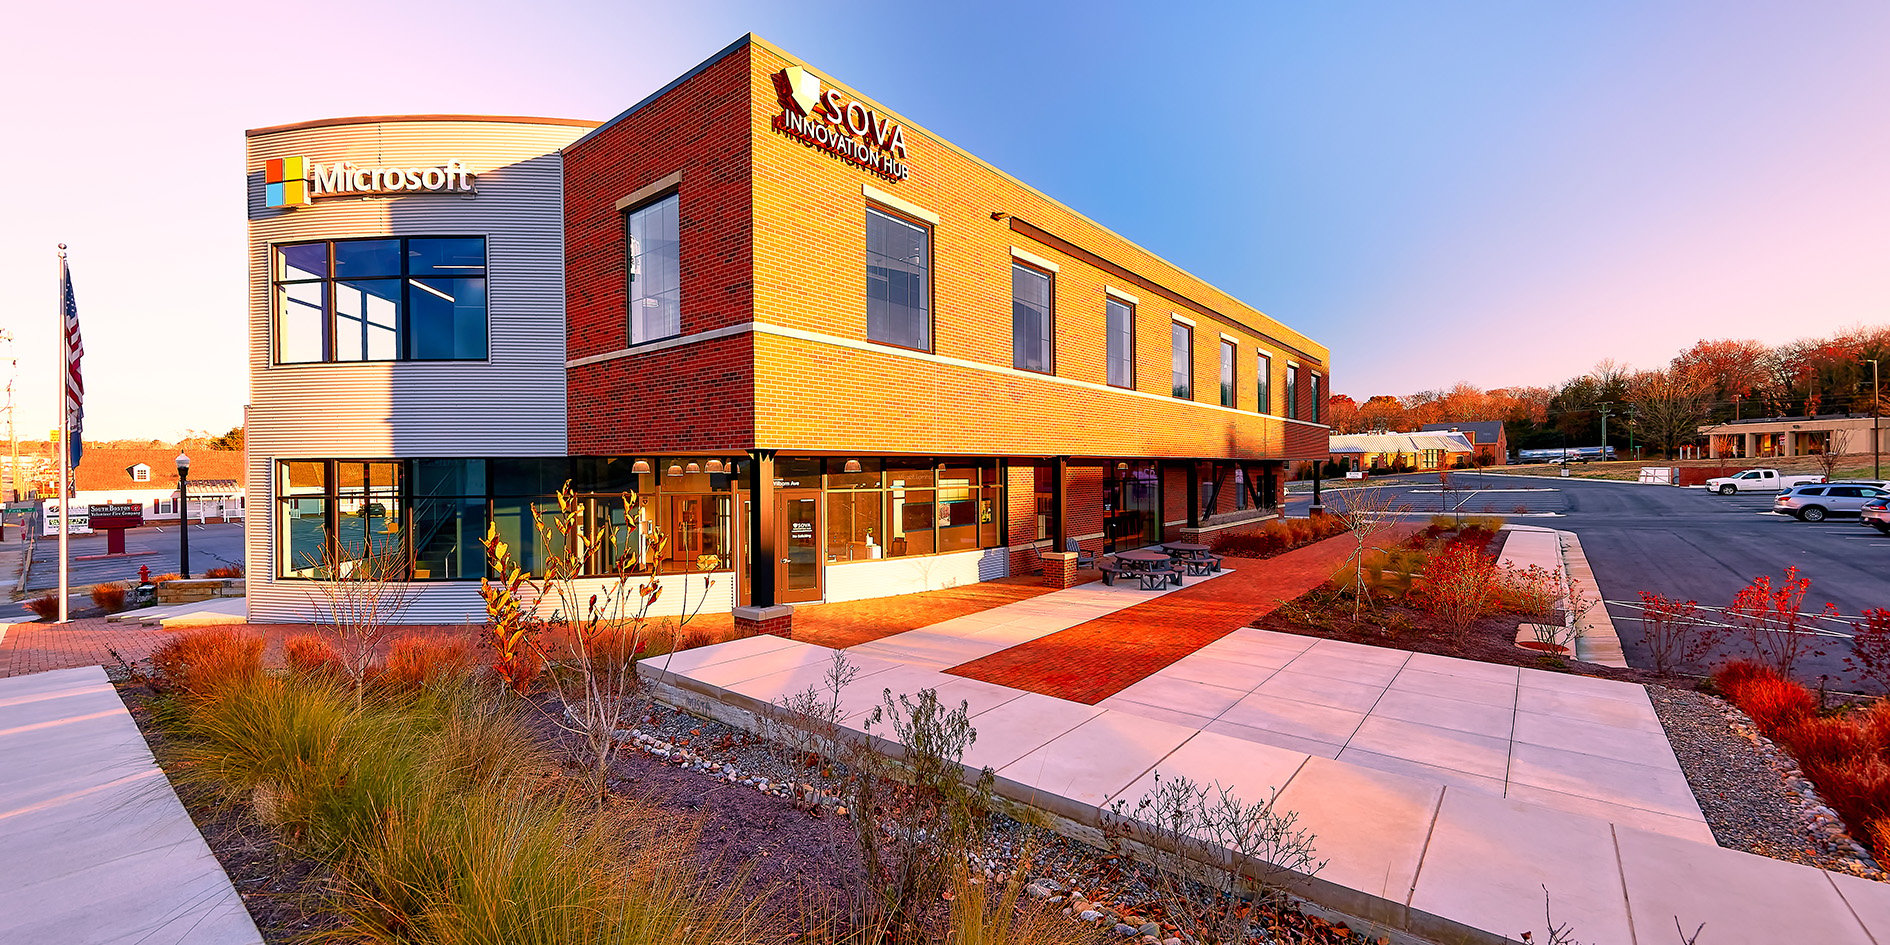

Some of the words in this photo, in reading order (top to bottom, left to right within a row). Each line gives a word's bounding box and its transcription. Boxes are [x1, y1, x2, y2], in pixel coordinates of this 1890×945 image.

[784, 108, 880, 168] INNOVATION
[882, 155, 910, 181] HUB
[825, 88, 908, 158] SOVA
[313, 158, 474, 194] Microsoft
